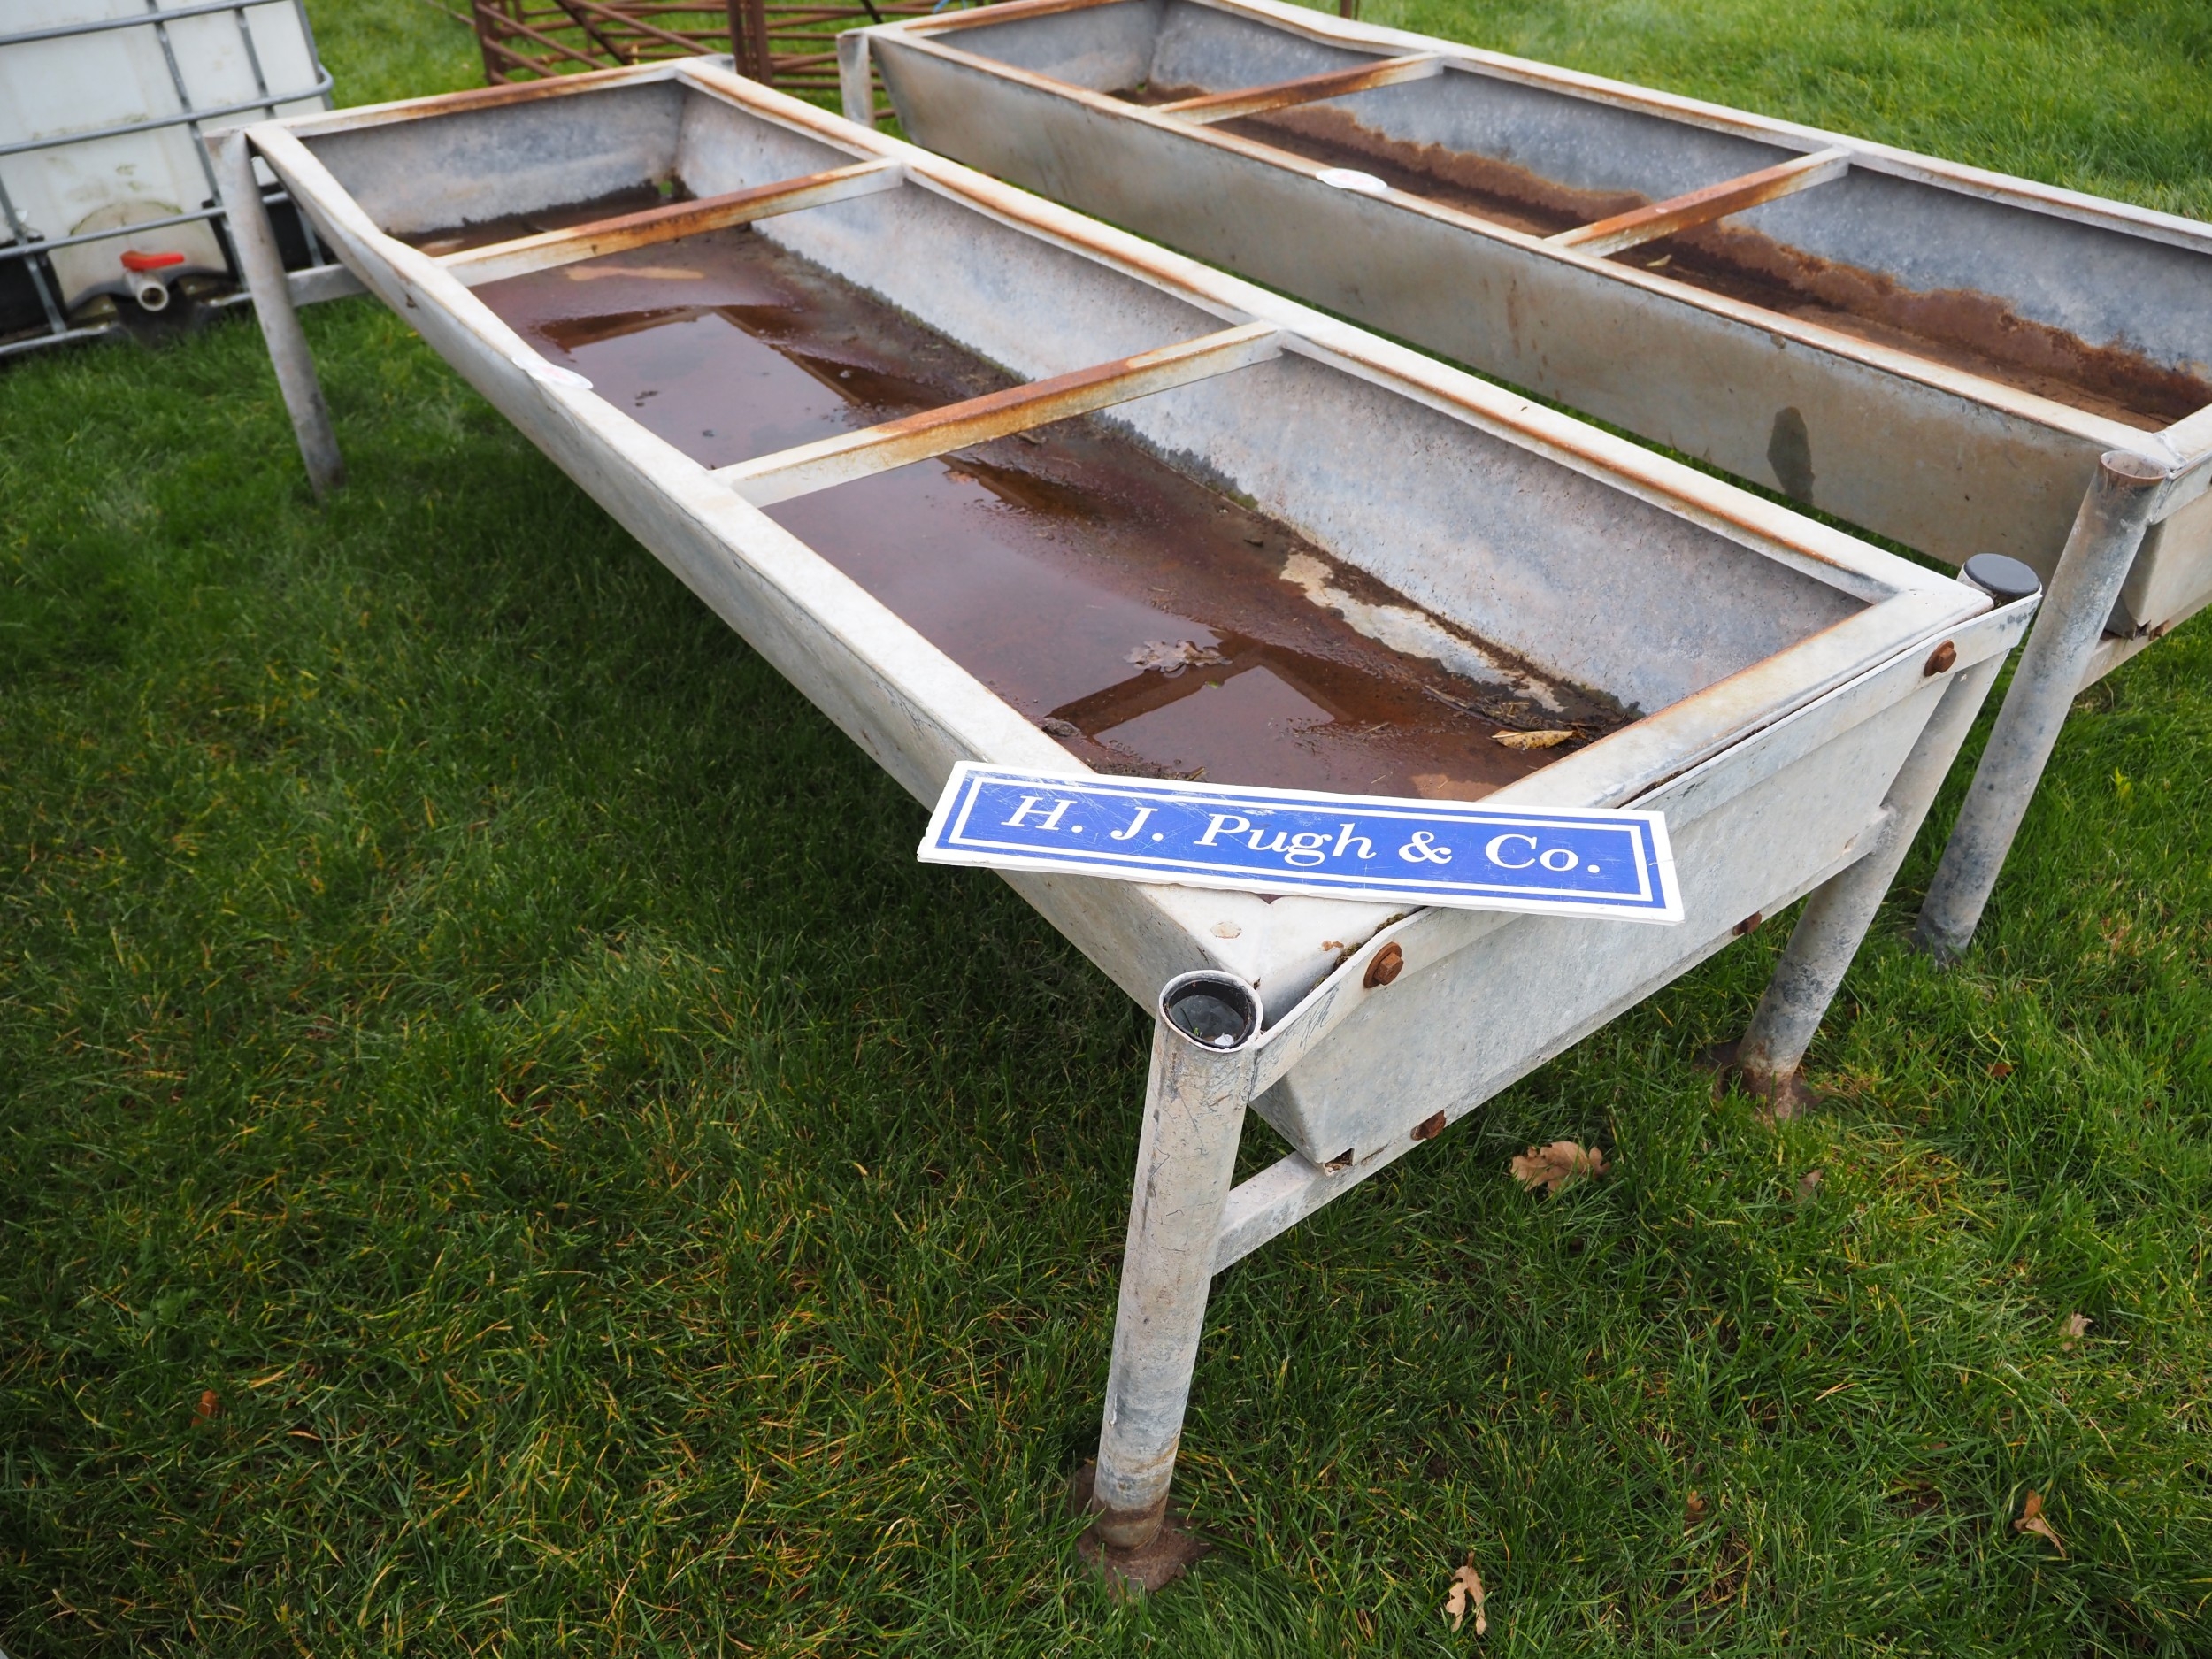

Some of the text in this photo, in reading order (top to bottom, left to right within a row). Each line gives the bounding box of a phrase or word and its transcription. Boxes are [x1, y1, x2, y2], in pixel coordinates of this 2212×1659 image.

[1000, 793, 1601, 874] H. J. Pugh & Co.
